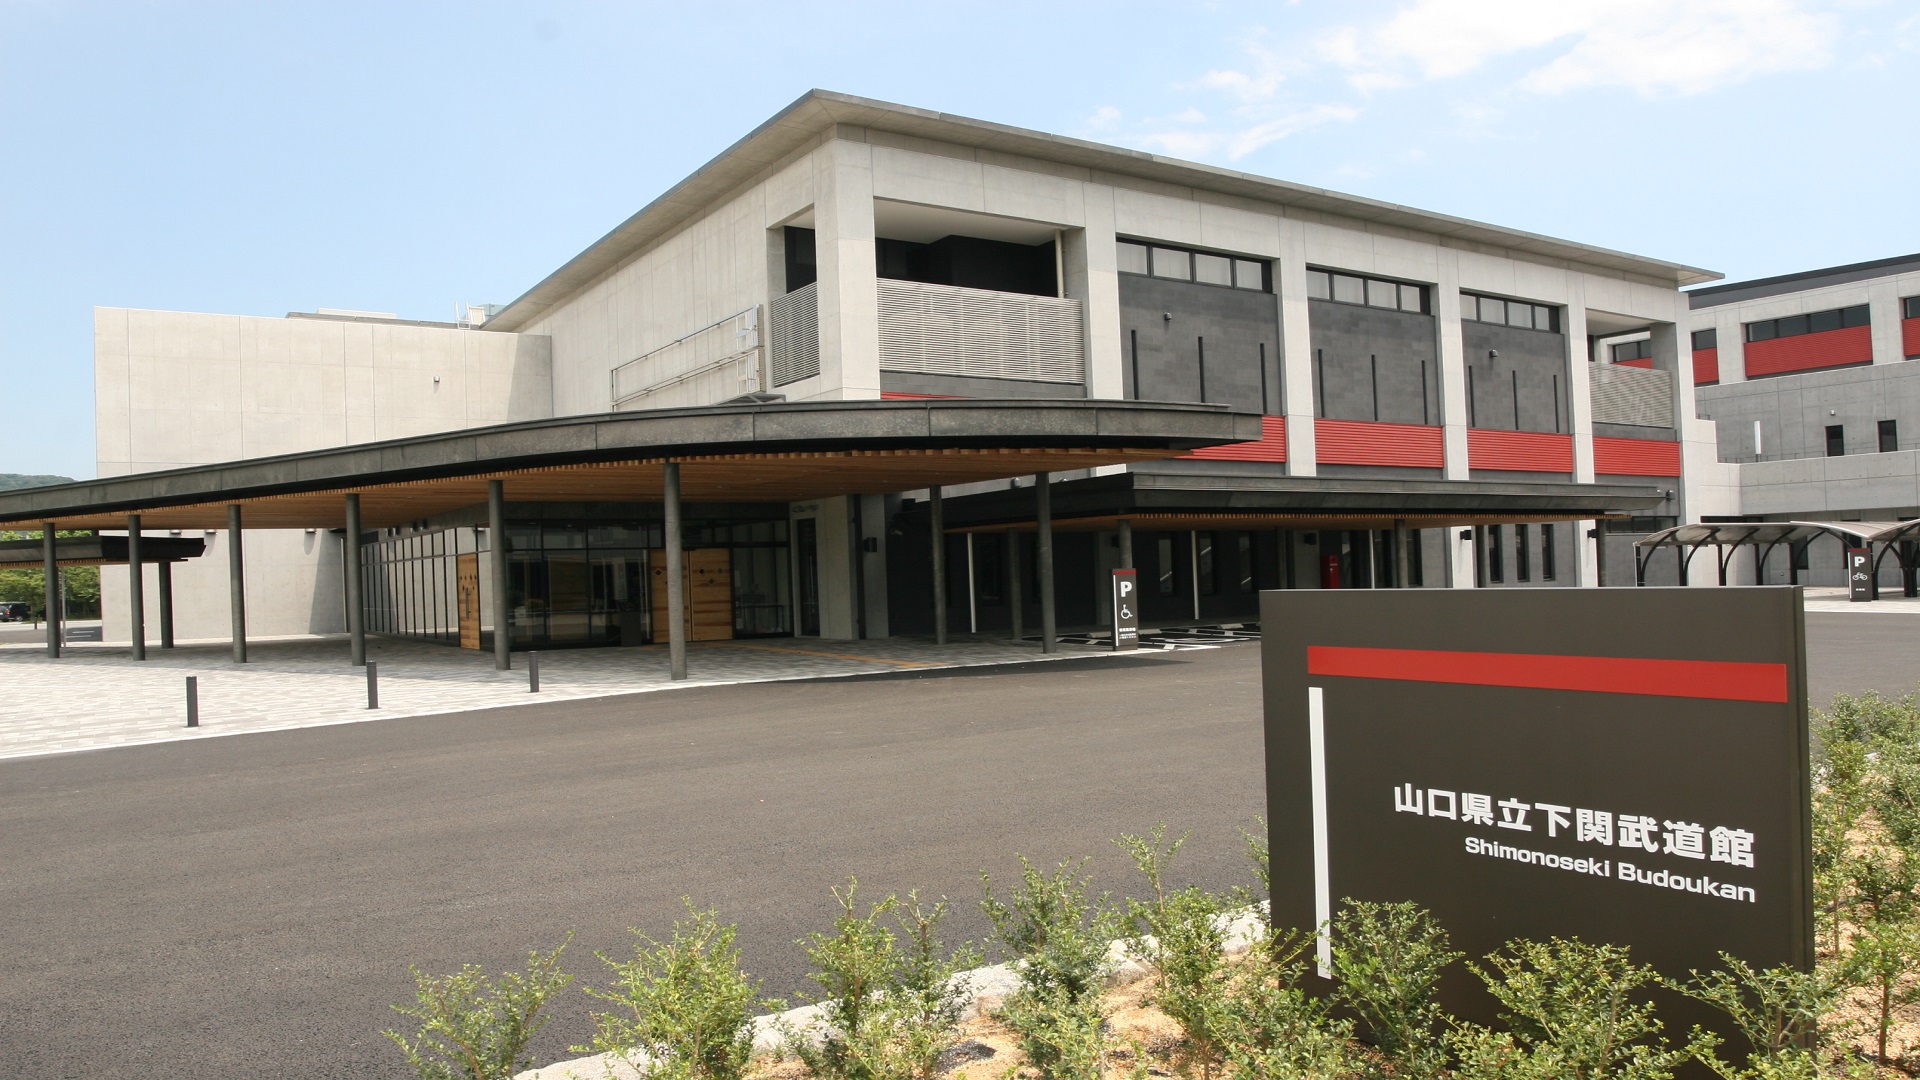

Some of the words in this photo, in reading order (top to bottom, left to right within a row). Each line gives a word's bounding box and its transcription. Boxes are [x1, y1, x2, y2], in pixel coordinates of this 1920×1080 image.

[1854, 556, 1865, 567] P
[1120, 581, 1133, 597] P
[1394, 783, 1755, 868] 山口県立下関武道館
[1465, 837, 1610, 877] Shimonoseki
[1618, 862, 1755, 902] Budoukan
